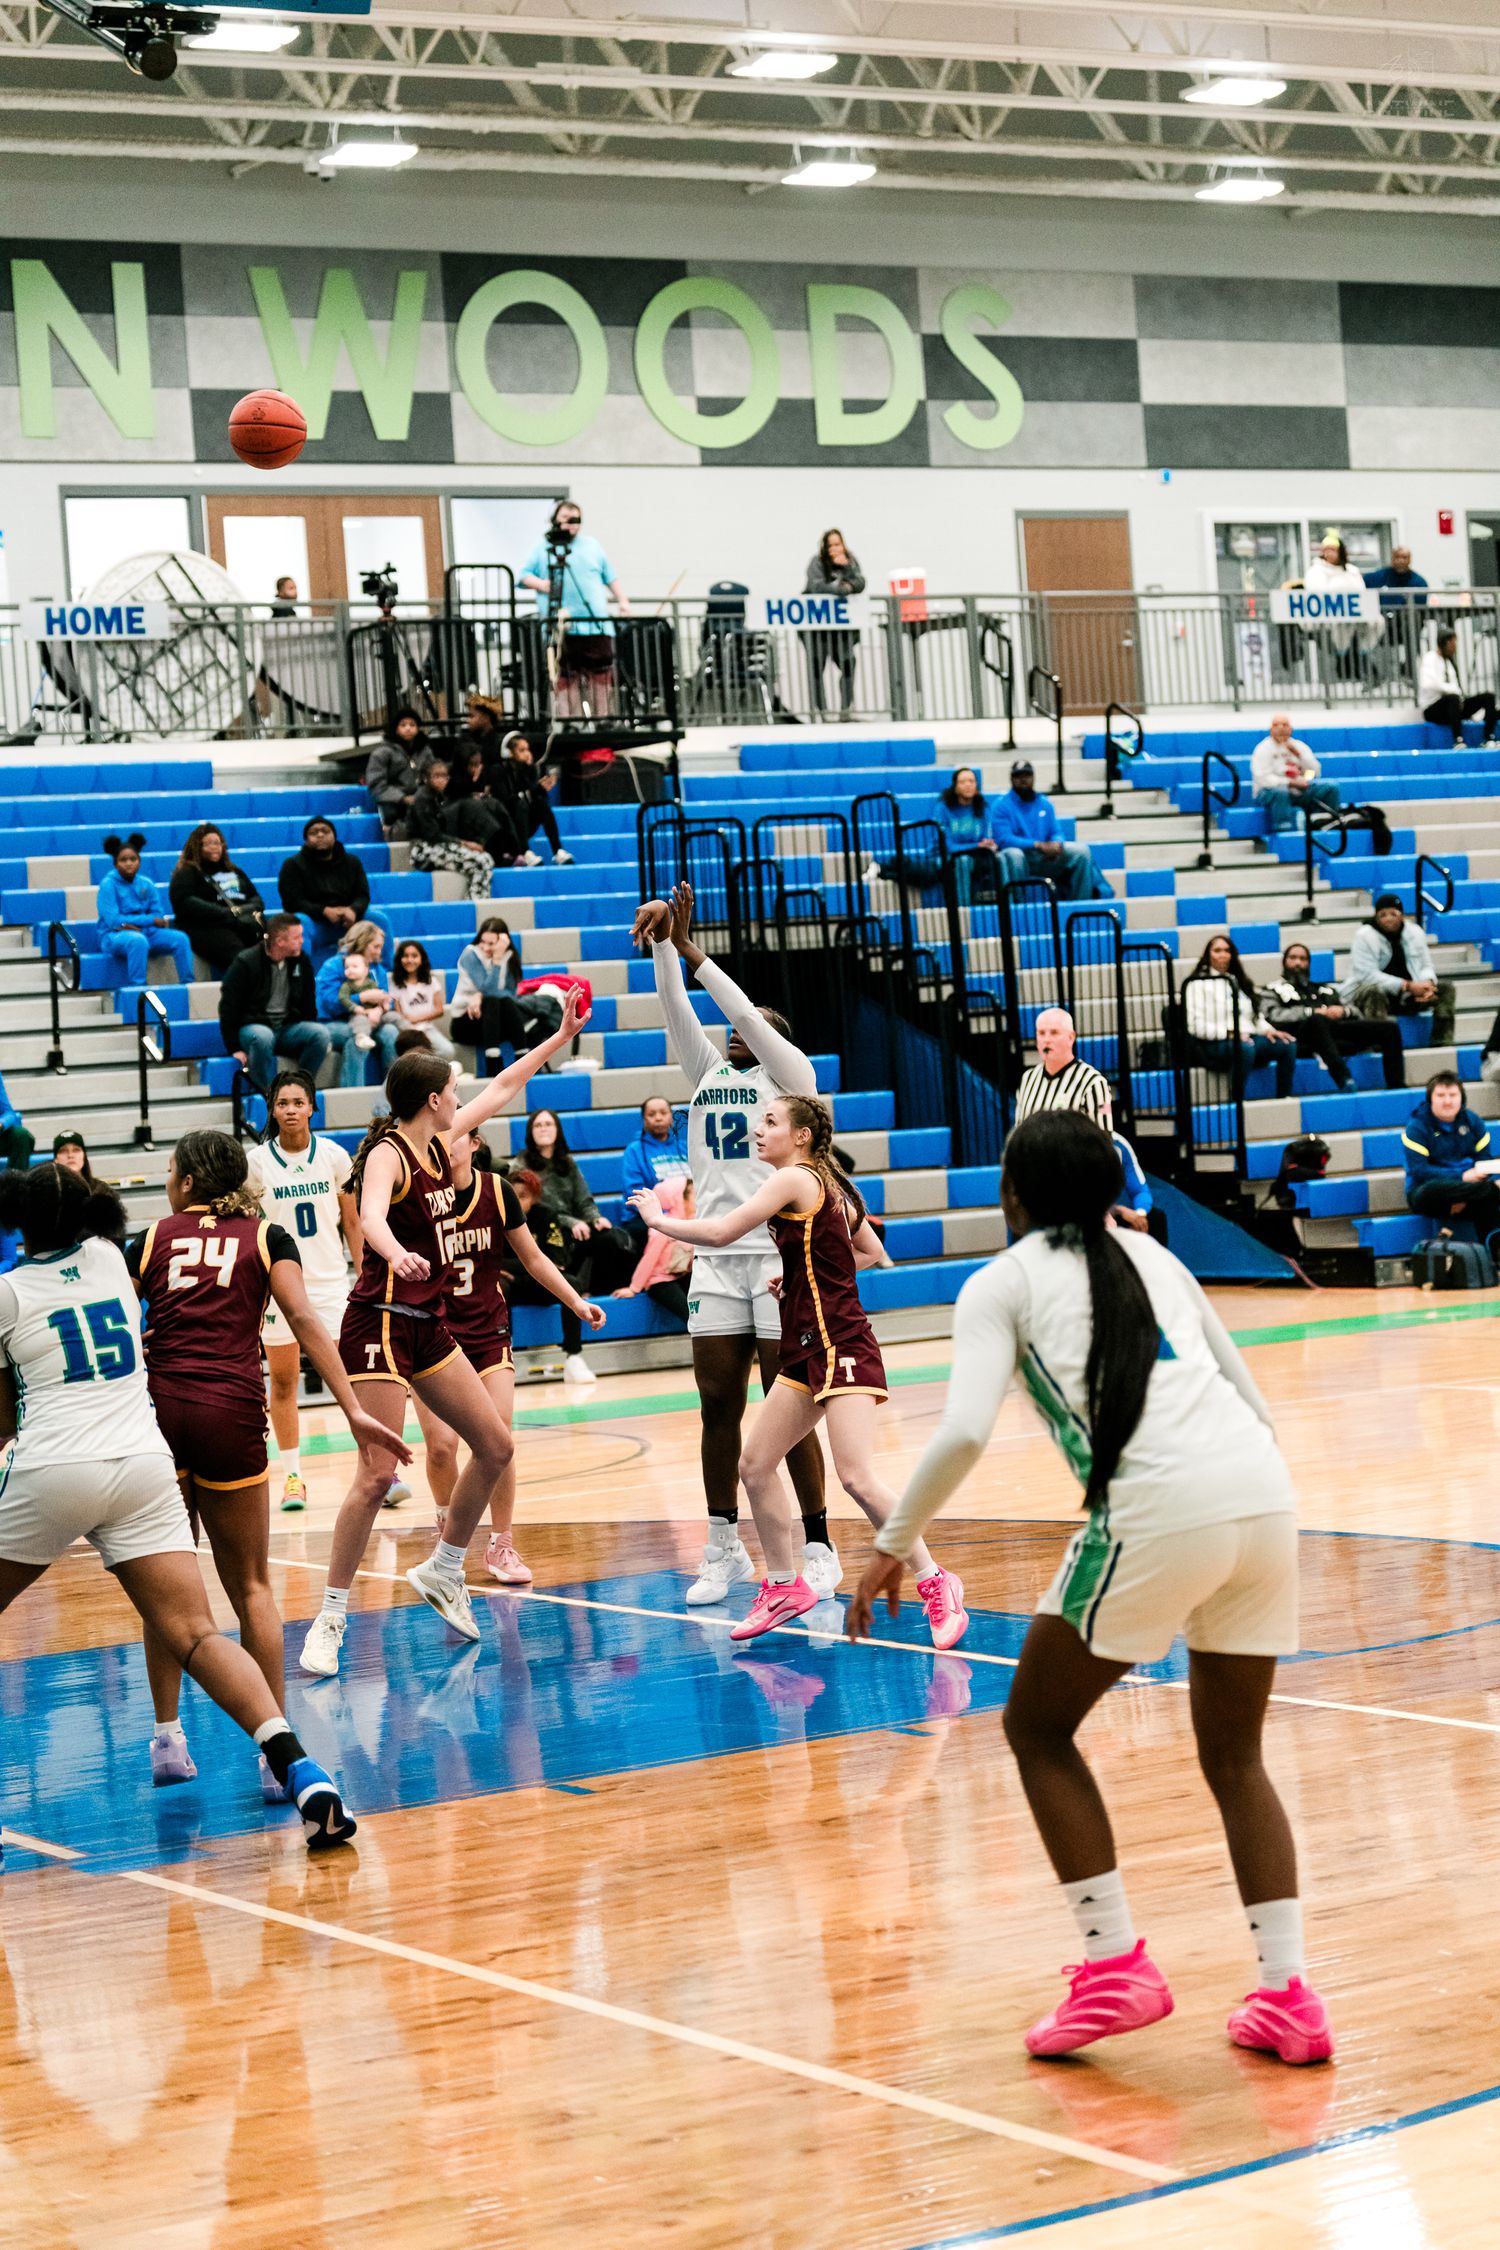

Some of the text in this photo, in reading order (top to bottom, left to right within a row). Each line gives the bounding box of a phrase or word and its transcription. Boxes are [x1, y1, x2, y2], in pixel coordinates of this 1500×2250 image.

[10, 258, 1026, 450] N WOODS
[766, 597, 849, 625] HOME
[1289, 594, 1361, 617] HOME
[45, 606, 145, 635] HOME
[693, 1088, 757, 1106] WARRIORS
[705, 1111, 750, 1160] 42
[272, 1181, 329, 1199] WARRIORS
[295, 1202, 317, 1238] 0
[168, 1237, 240, 1290] 24
[453, 1258, 475, 1296] 3
[47, 1297, 136, 1384] 15
[365, 1343, 381, 1369] T
[839, 1356, 857, 1383] T
